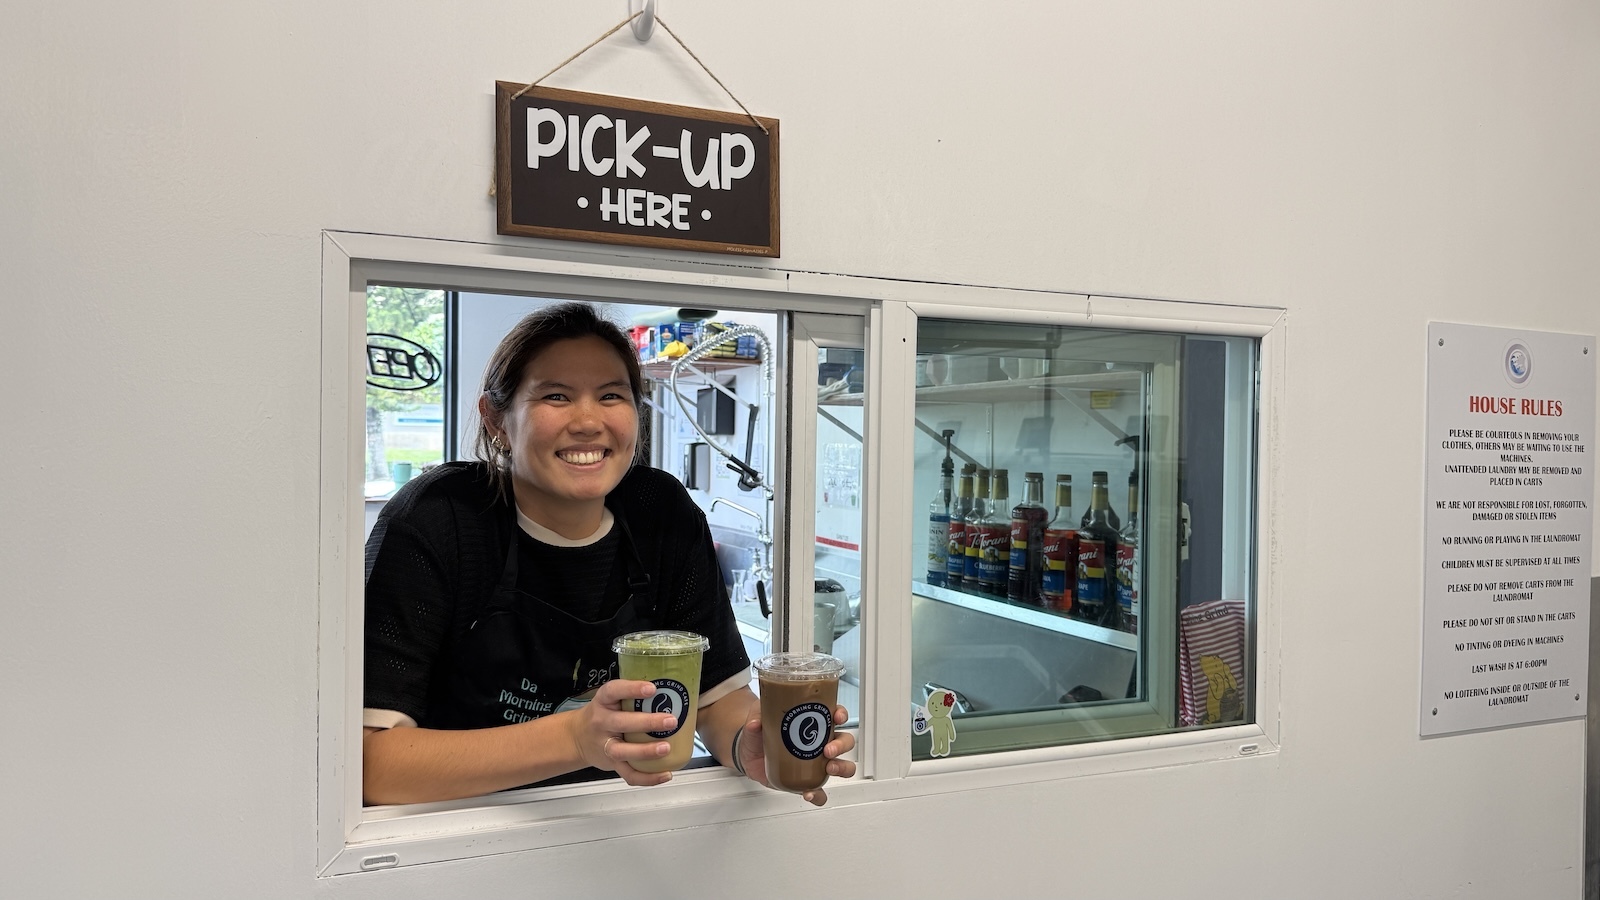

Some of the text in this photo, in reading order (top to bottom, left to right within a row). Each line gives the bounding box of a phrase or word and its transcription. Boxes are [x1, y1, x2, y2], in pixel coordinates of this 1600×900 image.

[527, 107, 755, 190] PICK-UP
[600, 187, 692, 231] HERE
[1470, 396, 1562, 416] HOUSE RULES
[1449, 429, 1579, 441] PLEASE BE COURTEOUS IN REMOVING YOUR
[1442, 441, 1473, 450] CLOTHES,
[1476, 442, 1500, 450] OTHERS
[1502, 442, 1515, 451] MAY
[1517, 443, 1525, 451] BE
[1527, 443, 1551, 451] WAITING
[1553, 444, 1560, 452] TO
[1562, 444, 1572, 452] USE
[1501, 454, 1533, 463] MACHINES.
[1445, 465, 1486, 473] UNATTENDED
[1489, 466, 1517, 474] LAUNDRY
[1518, 466, 1530, 474] MAY
[1532, 466, 1540, 474] BE
[1542, 466, 1569, 474] REMOVED
[1524, 478, 1542, 486] CARTS
[1436, 501, 1446, 509] WE
[1448, 501, 1460, 509] ARE
[1463, 501, 1476, 509] NOT
[1478, 501, 1520, 509] RESPONSIBLE
[1536, 501, 1551, 509] LOST,
[1553, 501, 1587, 509] FORGOTTEN,
[1472, 512, 1557, 520] DAMAGED OR STOLEN ITEMS
[979, 533, 1009, 550] Torani
[1442, 536, 1451, 544] NO
[1454, 536, 1482, 544] RUNNING
[1496, 535, 1520, 543] PLAYING
[1523, 535, 1529, 543] IN
[1544, 534, 1581, 542] LAUNDROMAT
[1442, 556, 1580, 569] CHILDREN MUST BE SUPERVISED AT ALL TIMES
[1448, 579, 1574, 592] PLEASE DO NOT REMOVE CARTS FROM THE
[1493, 592, 1533, 602] LAUNDROMAT
[1443, 612, 1575, 628] PLEASE DO NOT SIT OR STAND IN THE CARTS
[1455, 635, 1563, 651] NO TINTING OR DYEING IN MACHINES
[1472, 659, 1547, 673] LAST WASH IS AT 6:00PM
[520, 677, 538, 694] Da
[1444, 679, 1569, 700] NO LOITERING INSIDE OR OUTSIDE OF THE
[499, 689, 553, 712] Morning
[1489, 695, 1529, 706] LAUNDROMAT
[786, 705, 811, 722] MORNING
